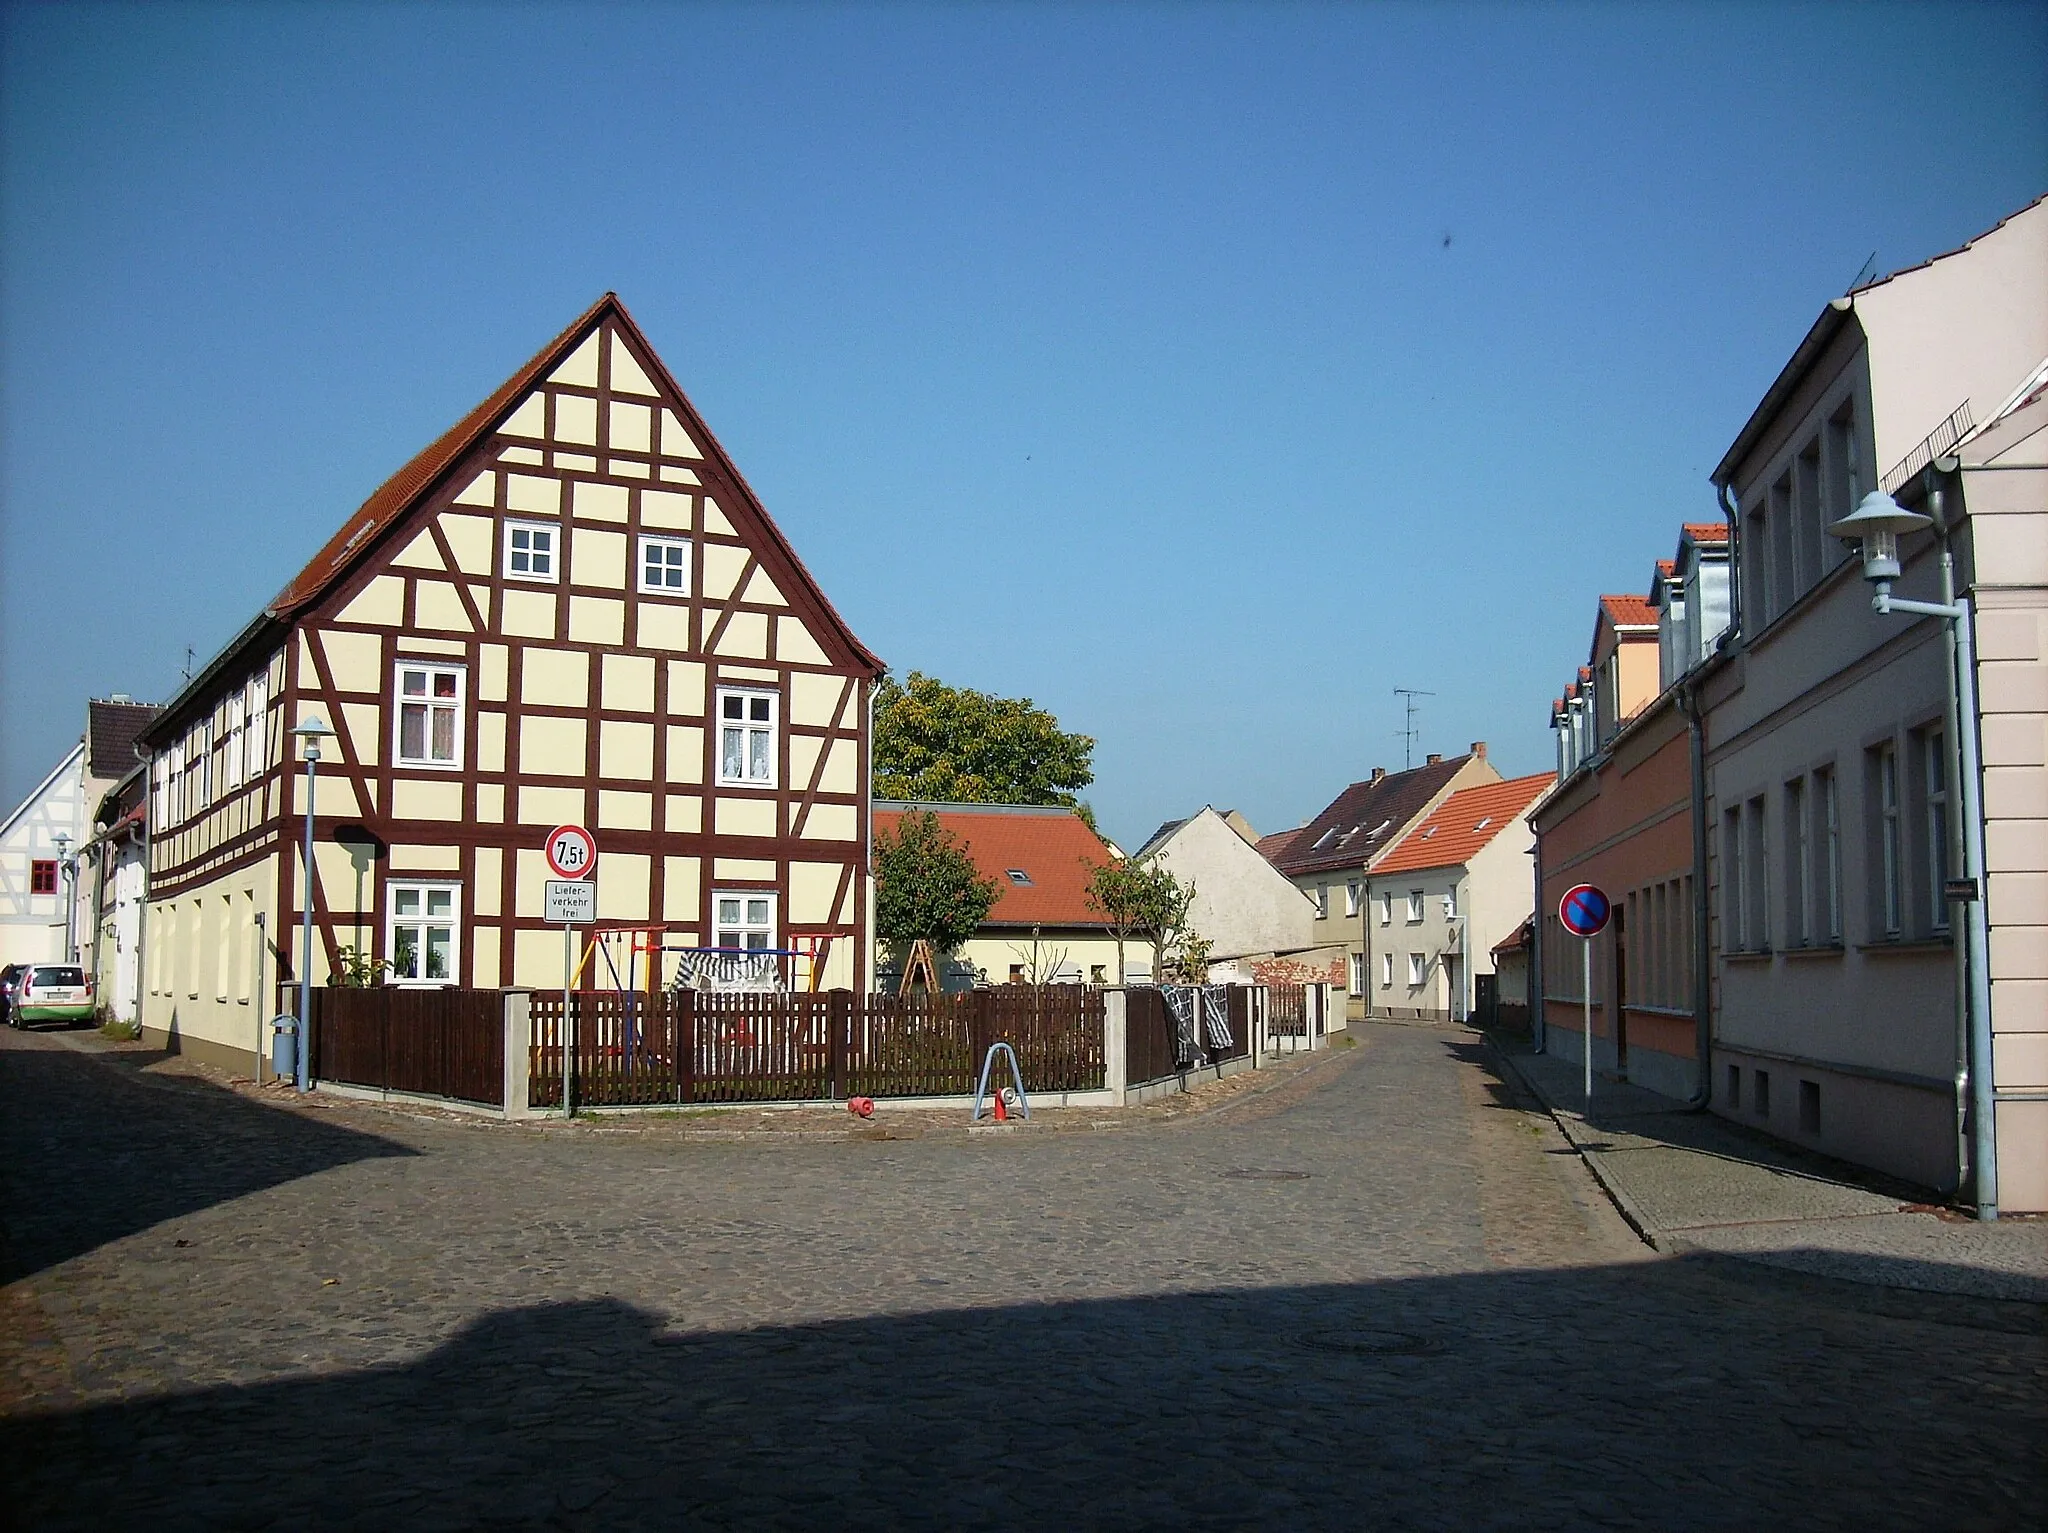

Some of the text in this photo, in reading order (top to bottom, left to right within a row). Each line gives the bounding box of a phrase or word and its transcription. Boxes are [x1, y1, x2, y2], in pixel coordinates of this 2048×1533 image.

[557, 841, 584, 865] 7,5t
[554, 885, 586, 895] Liefer-
[552, 898, 588, 907] verkehr
[562, 908, 579, 918] frei
